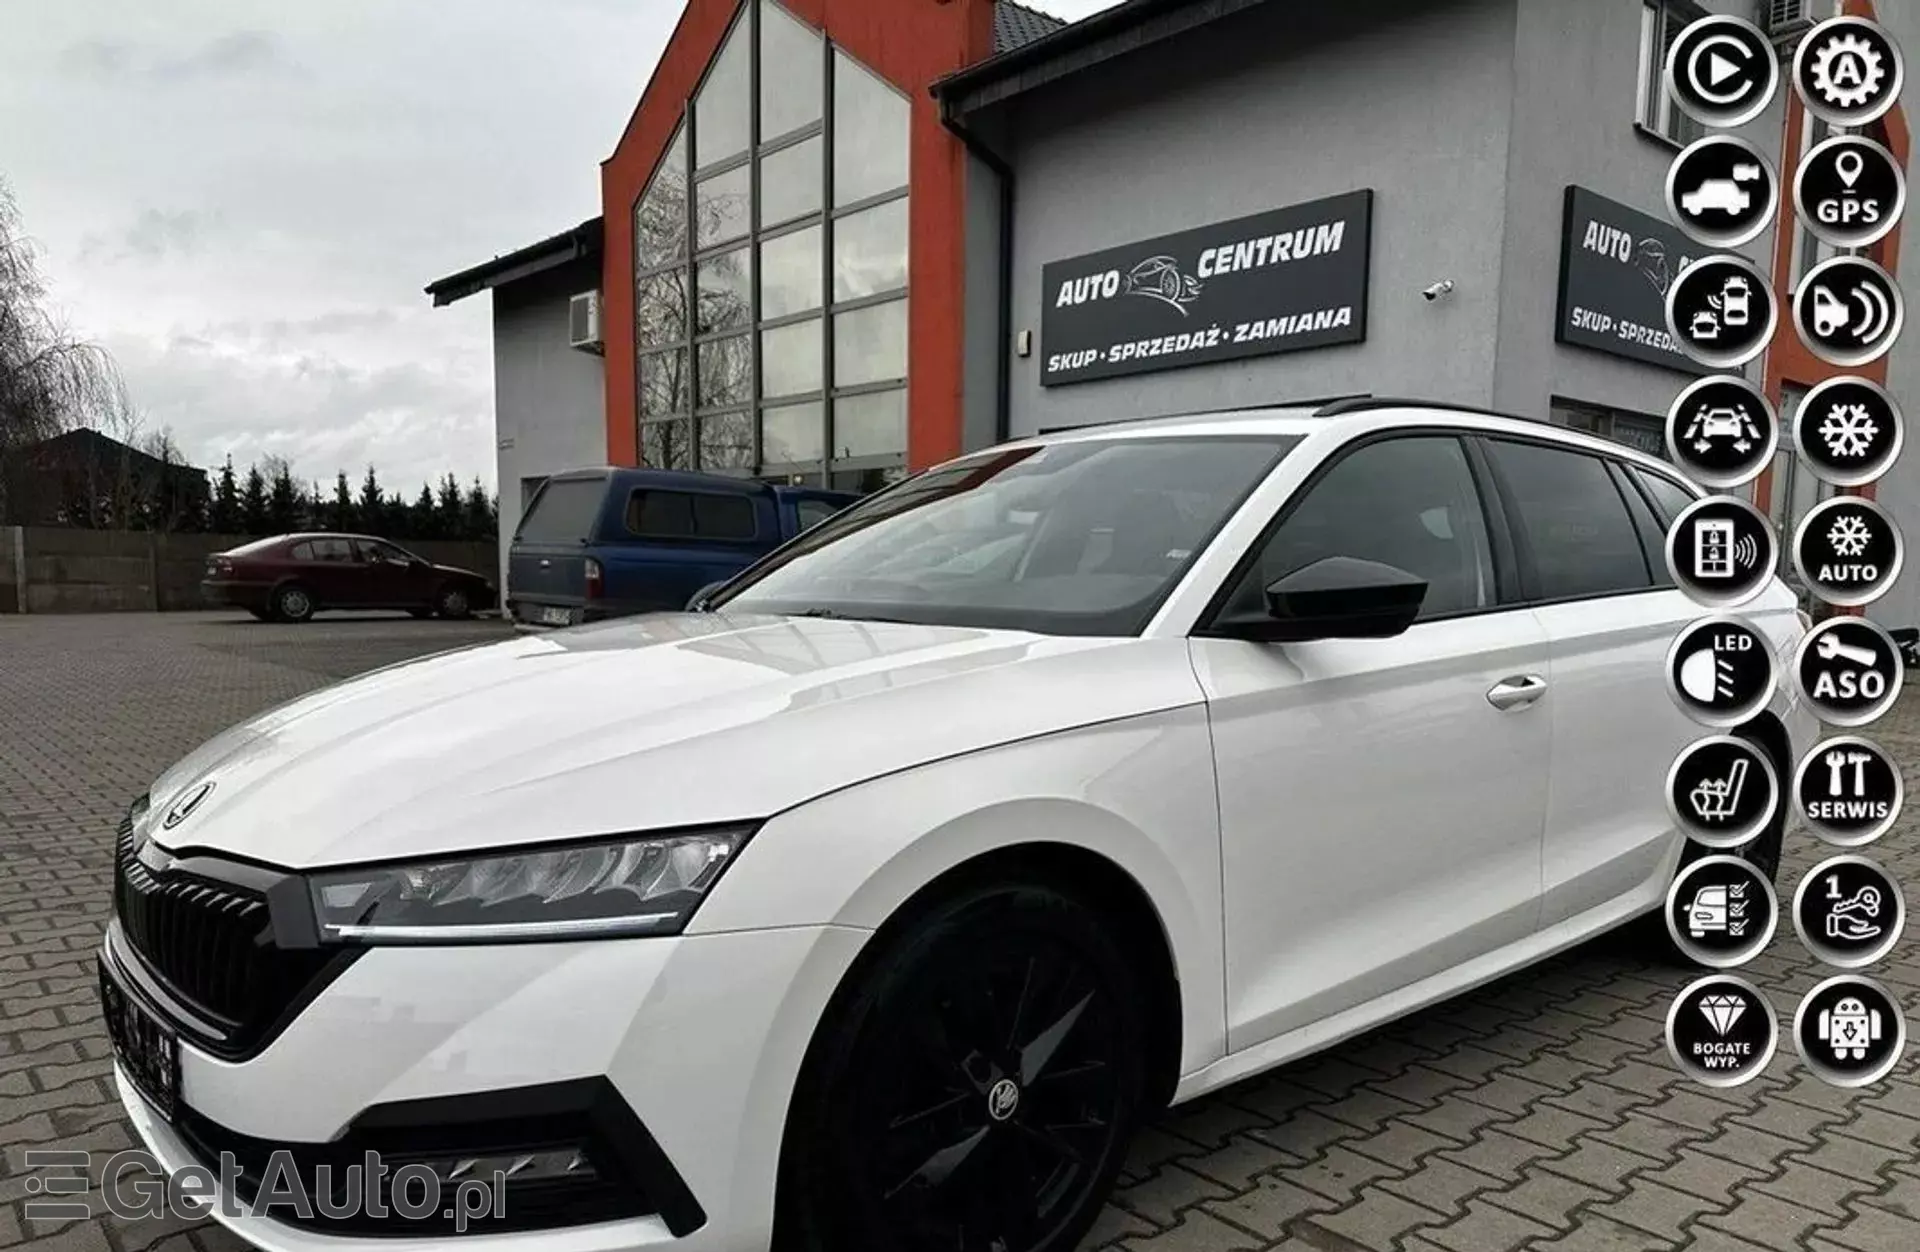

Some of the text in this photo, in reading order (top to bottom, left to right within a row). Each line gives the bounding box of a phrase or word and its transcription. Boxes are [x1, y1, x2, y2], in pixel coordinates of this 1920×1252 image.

[1056, 220, 1346, 308] AUTO CENTRUM
[1583, 219, 1632, 264] AUTO
[1048, 306, 1352, 373] SKUP SPRZEDAŻ ZAMIANA
[1571, 306, 1611, 332] SKUP
